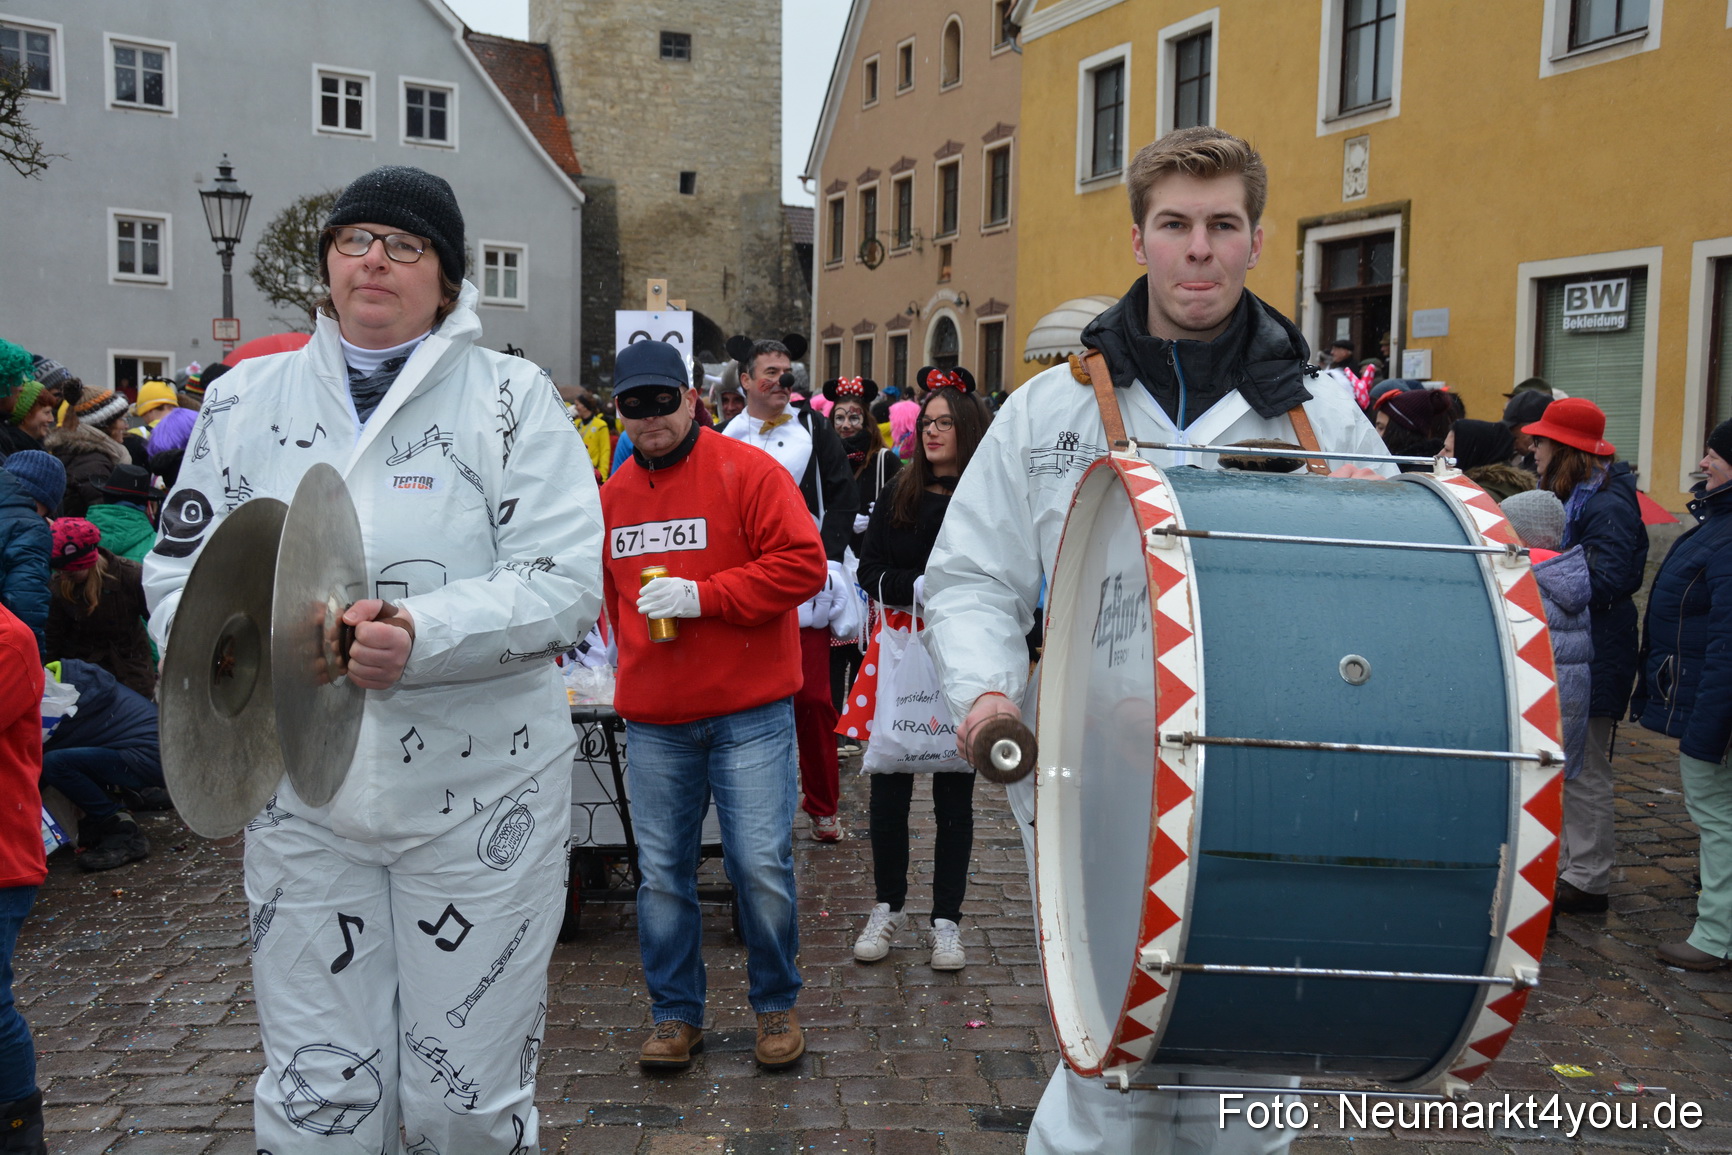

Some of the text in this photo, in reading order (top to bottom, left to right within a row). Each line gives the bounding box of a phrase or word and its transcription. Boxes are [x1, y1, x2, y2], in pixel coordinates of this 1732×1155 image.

[1566, 283, 1624, 312] BW
[1562, 314, 1626, 330] Bekleidung
[393, 476, 433, 490] TECTOR
[616, 523, 698, 553] 671-761
